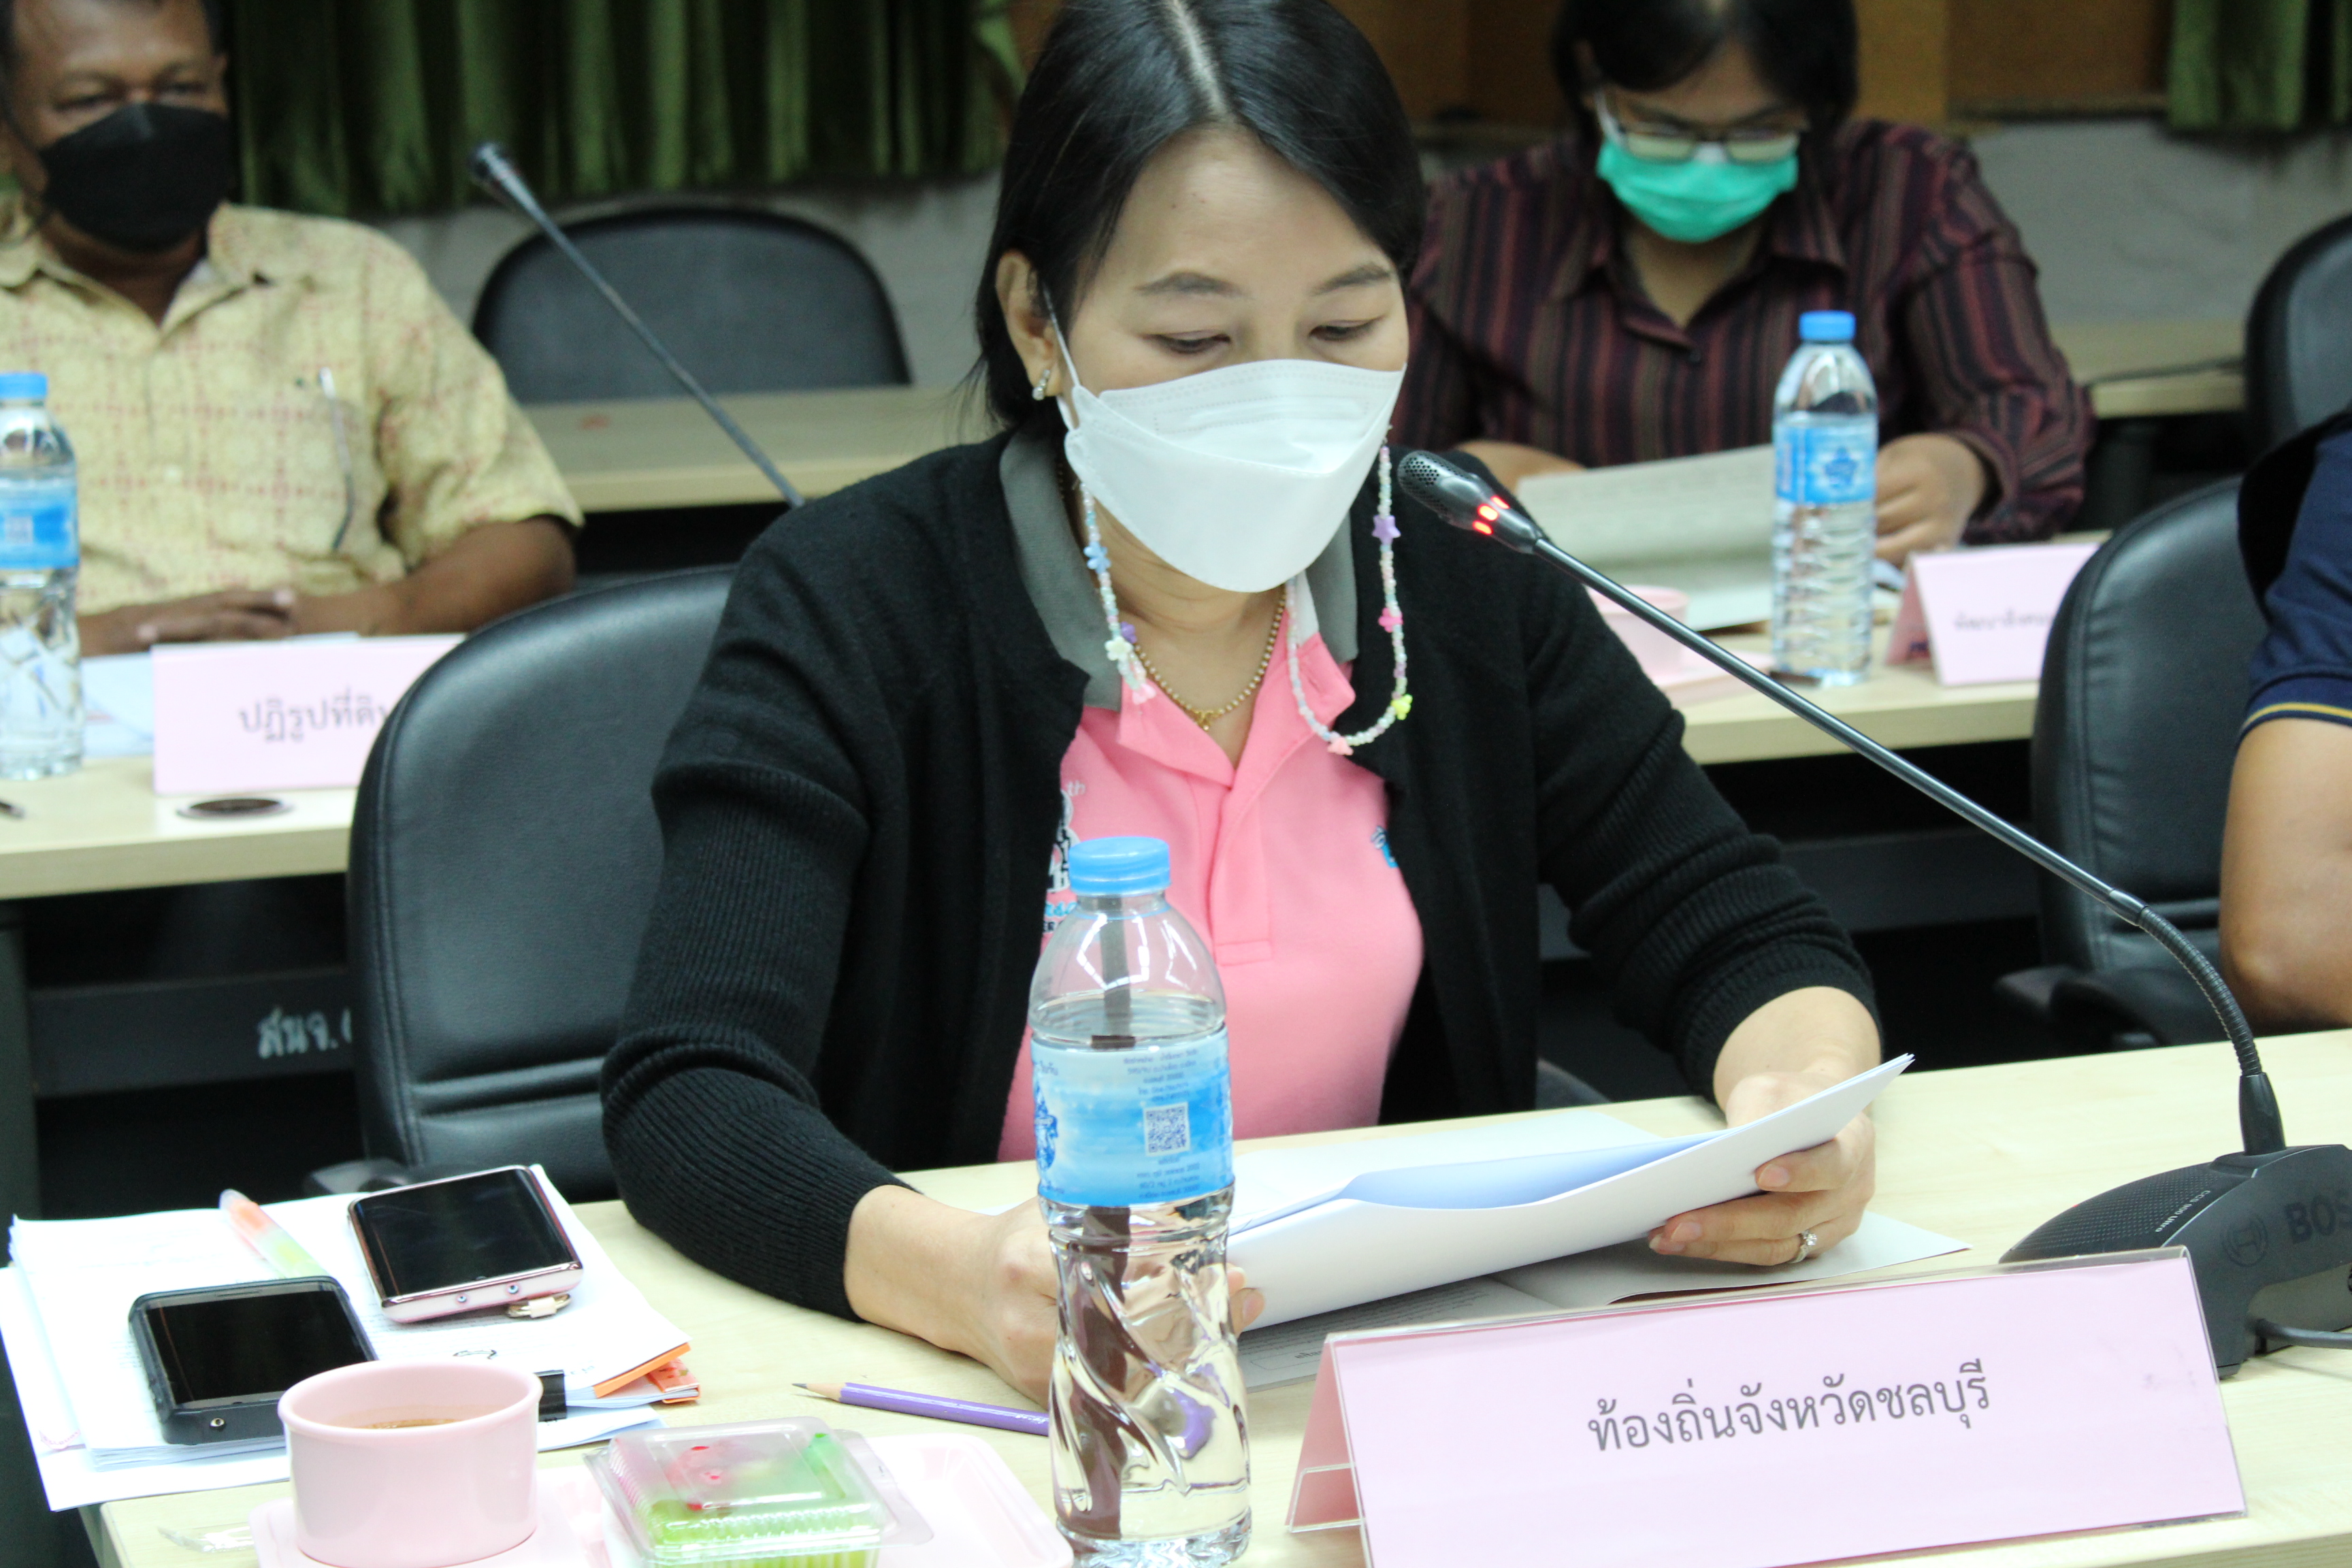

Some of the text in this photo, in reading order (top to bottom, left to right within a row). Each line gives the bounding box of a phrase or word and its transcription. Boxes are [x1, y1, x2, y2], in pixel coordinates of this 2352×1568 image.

[1588, 1358, 1990, 1451] ท้องถิ่นจังหวัดชลบุรี
